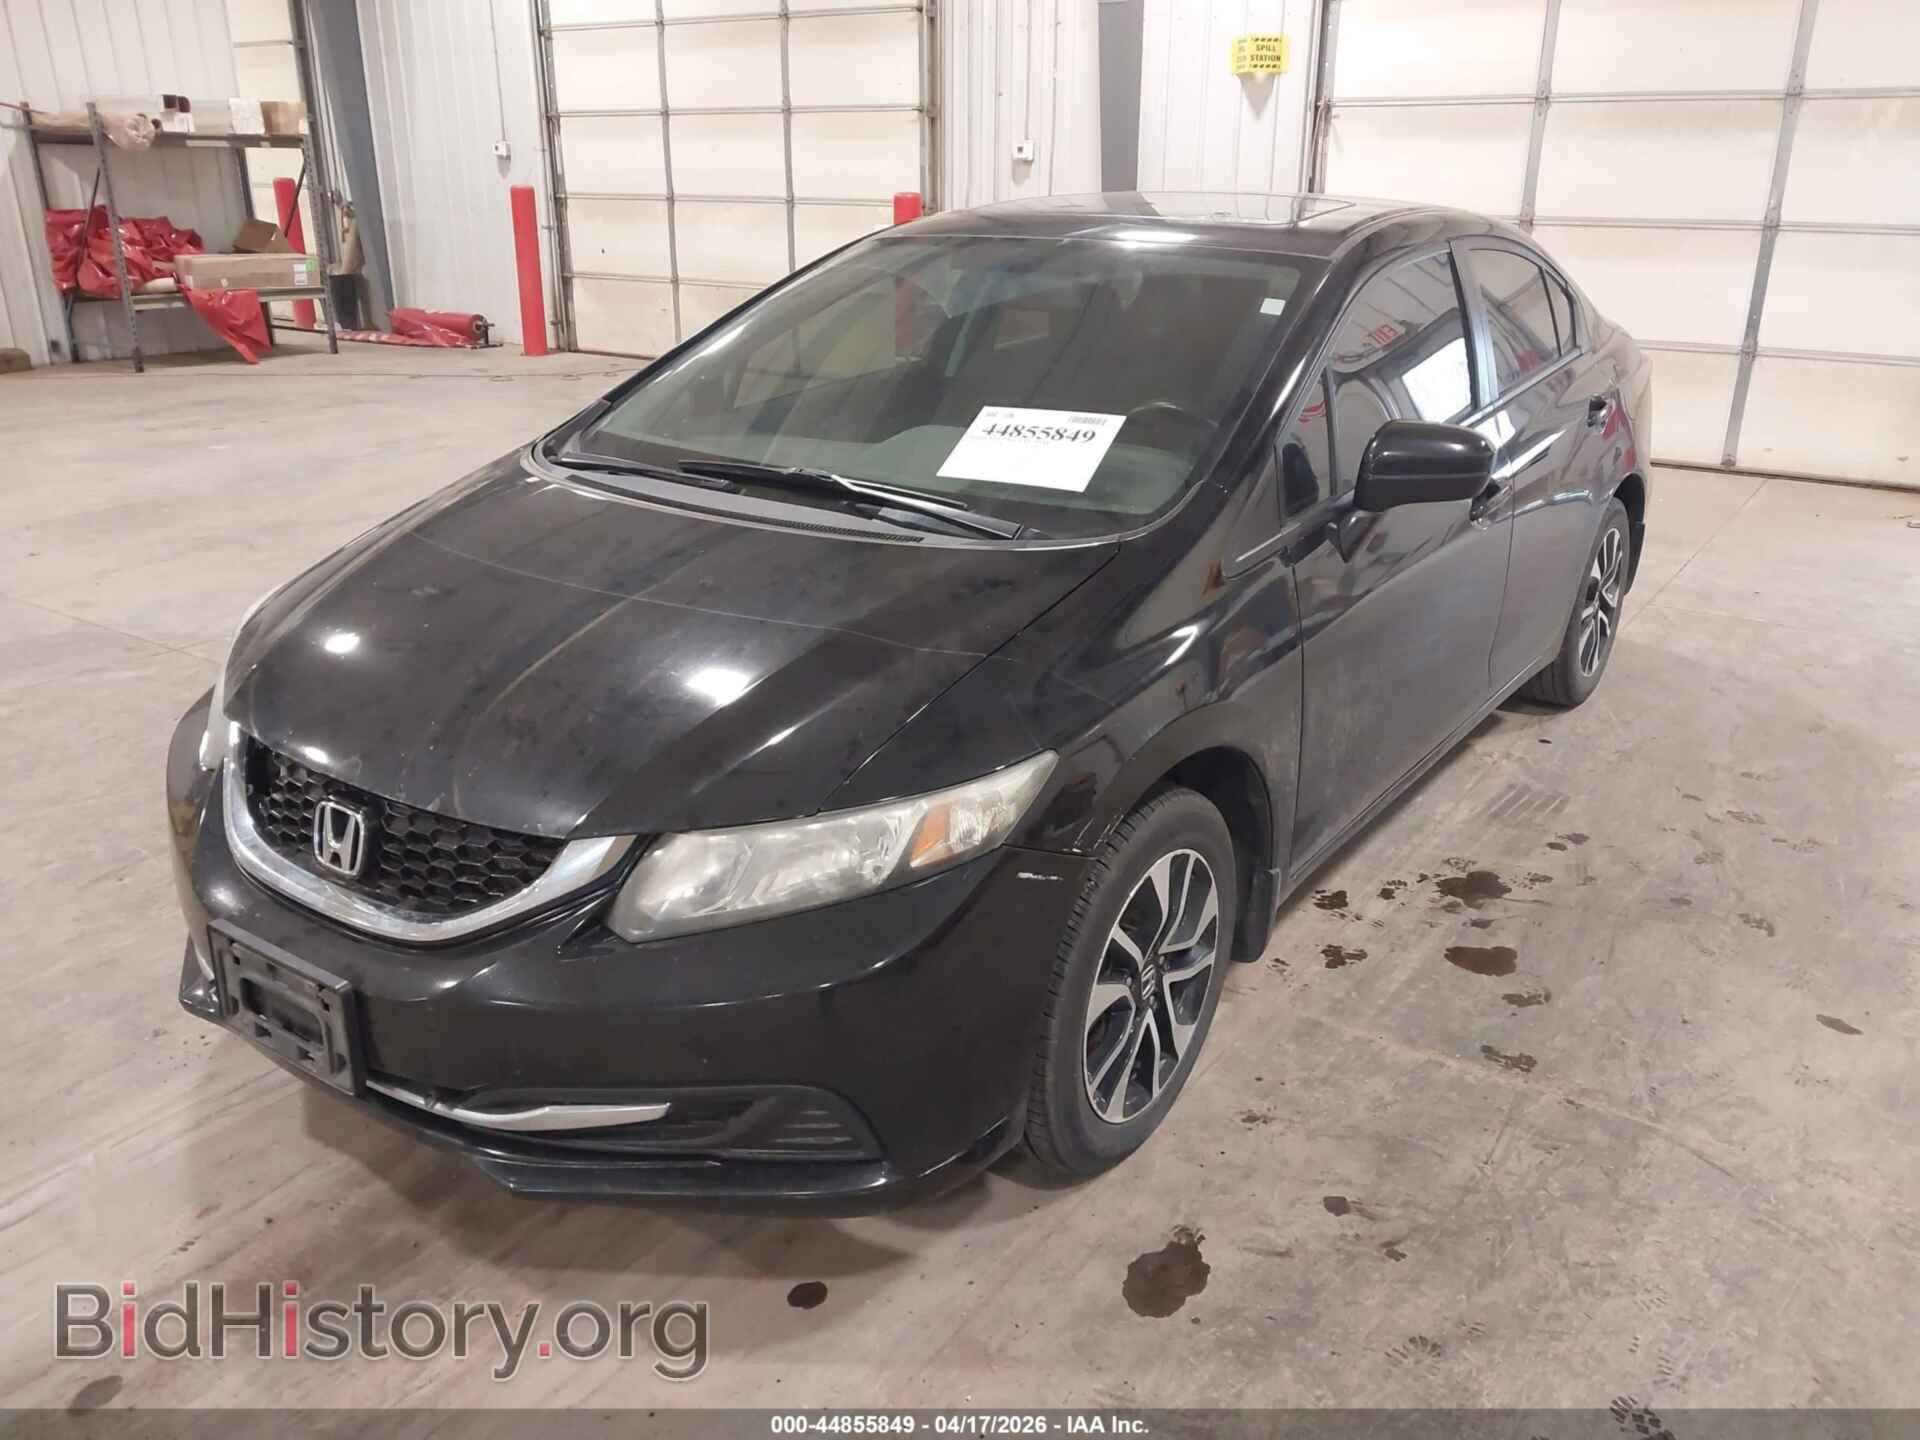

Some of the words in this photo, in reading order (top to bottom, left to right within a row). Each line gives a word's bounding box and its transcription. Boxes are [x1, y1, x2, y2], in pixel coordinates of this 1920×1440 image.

[1255, 43, 1276, 52] SPILL
[1250, 54, 1281, 62] STATION
[982, 422, 1097, 443] 44855849
